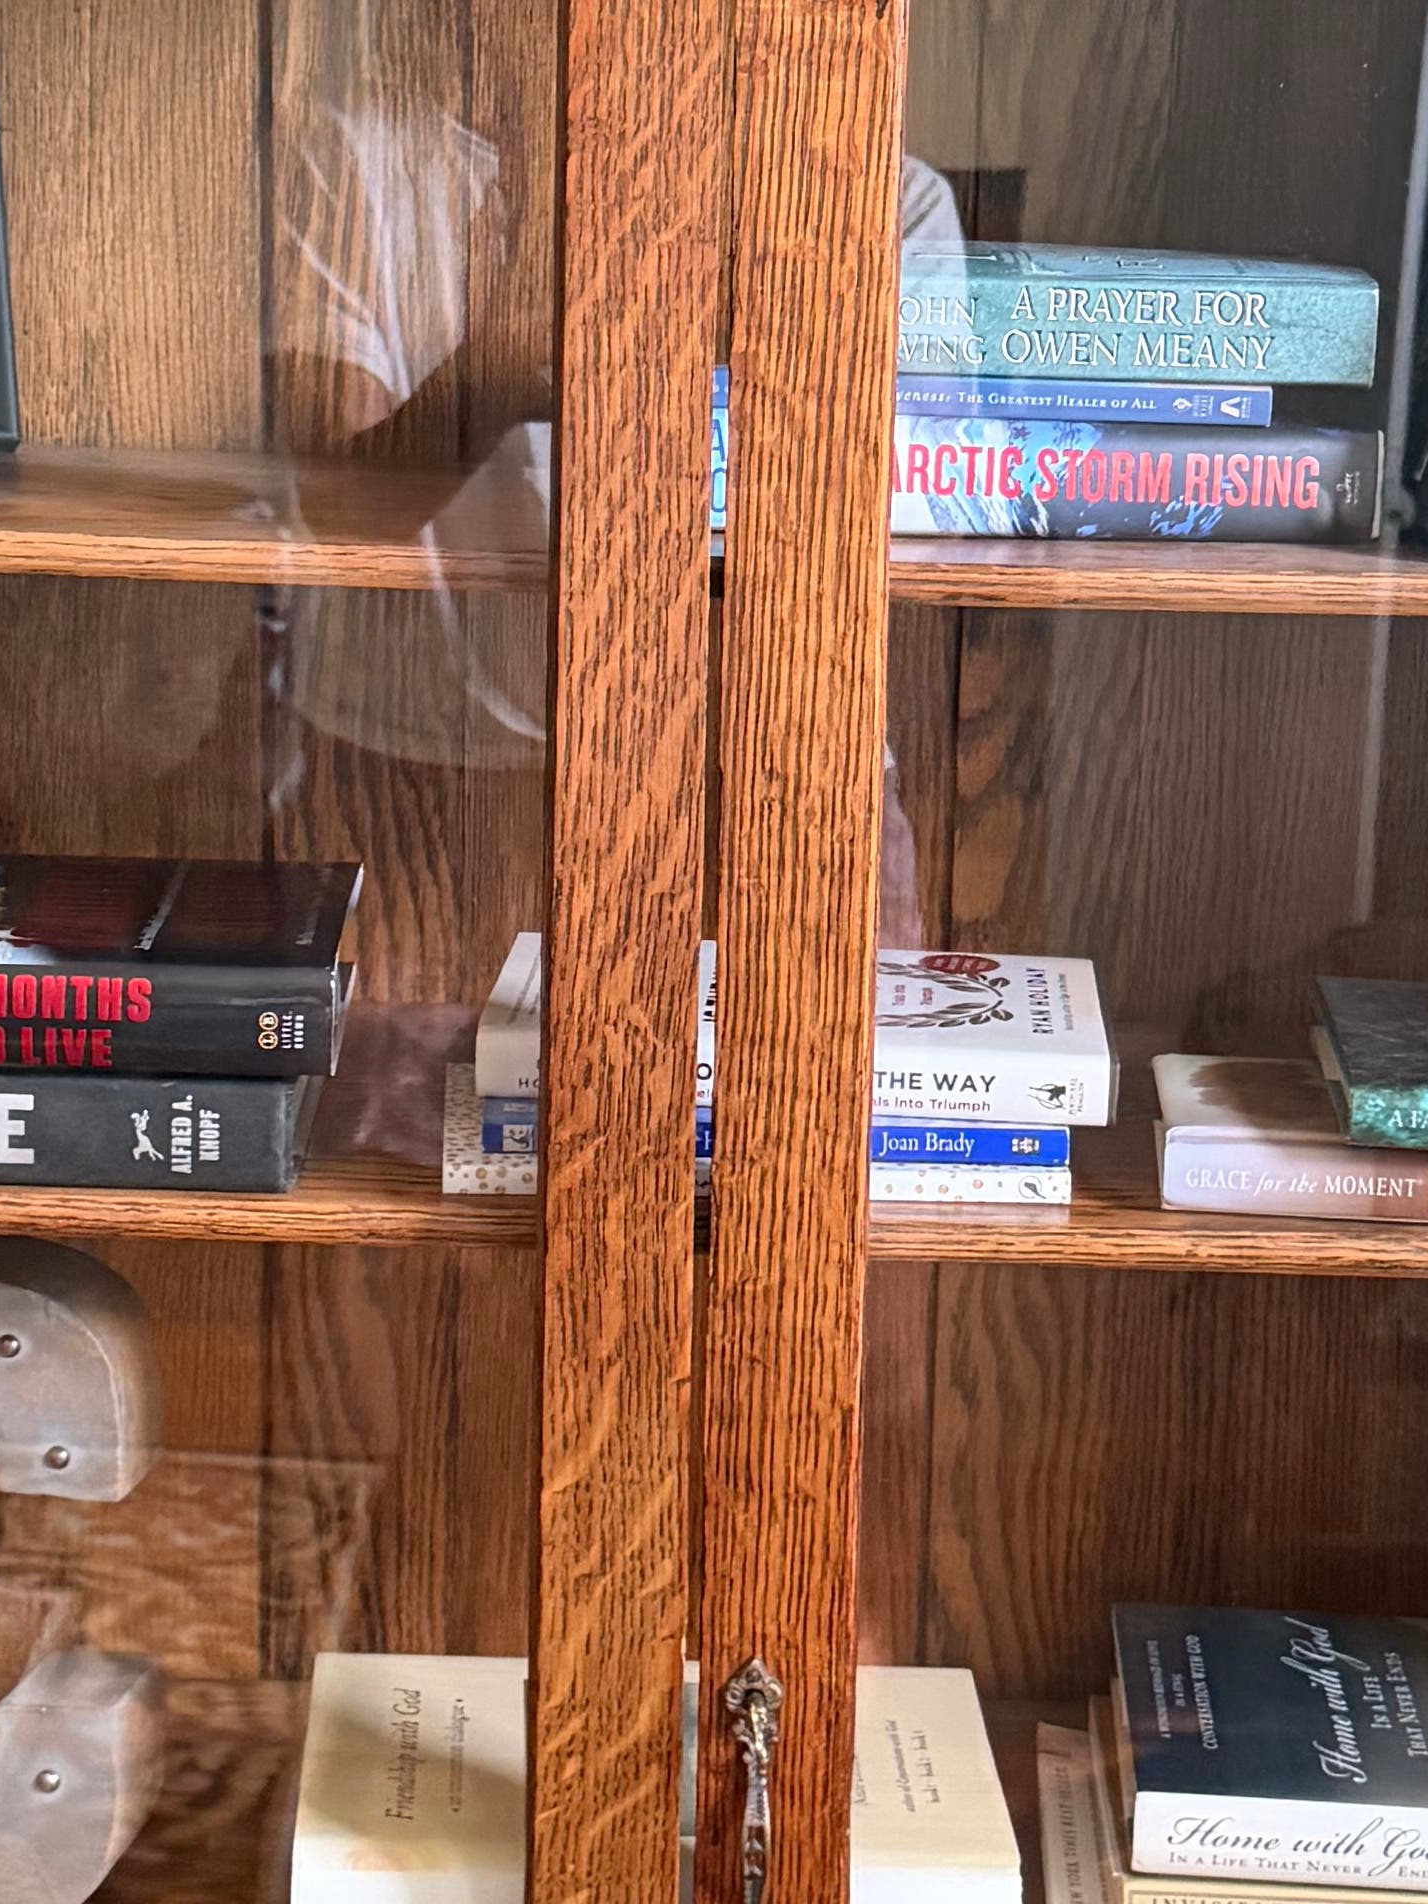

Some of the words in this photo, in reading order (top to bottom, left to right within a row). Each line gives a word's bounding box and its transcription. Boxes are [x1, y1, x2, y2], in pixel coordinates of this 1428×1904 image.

[1010, 285, 1037, 322] A
[1047, 286, 1183, 327] PRAYER
[1193, 291, 1271, 330] FOR
[1001, 328, 1123, 368] OWEN
[1133, 334, 1273, 371] MEANY
[1036, 447, 1174, 505] STORM
[1183, 452, 1320, 509] RISING
[21, 1026, 113, 1069] LIVE
[874, 1070, 923, 1090] THE
[933, 1072, 997, 1094] WAY
[929, 1098, 991, 1112] Triumph
[1388, 1108, 1406, 1129] A
[171, 1116, 193, 1174] ALFRED
[199, 1109, 221, 1162] KNOPF
[879, 1131, 919, 1157] Joan
[925, 1131, 976, 1158] Brady
[1185, 1167, 1252, 1193] GRACE
[1253, 1167, 1285, 1197] for
[1289, 1169, 1320, 1195] the
[1324, 1173, 1418, 1200] MOMENT
[1284, 1615, 1372, 1673] God
[1280, 1654, 1349, 1712] with
[1312, 1713, 1368, 1785] Home
[1167, 1816, 1282, 1853] Home
[1292, 1816, 1385, 1858] with
